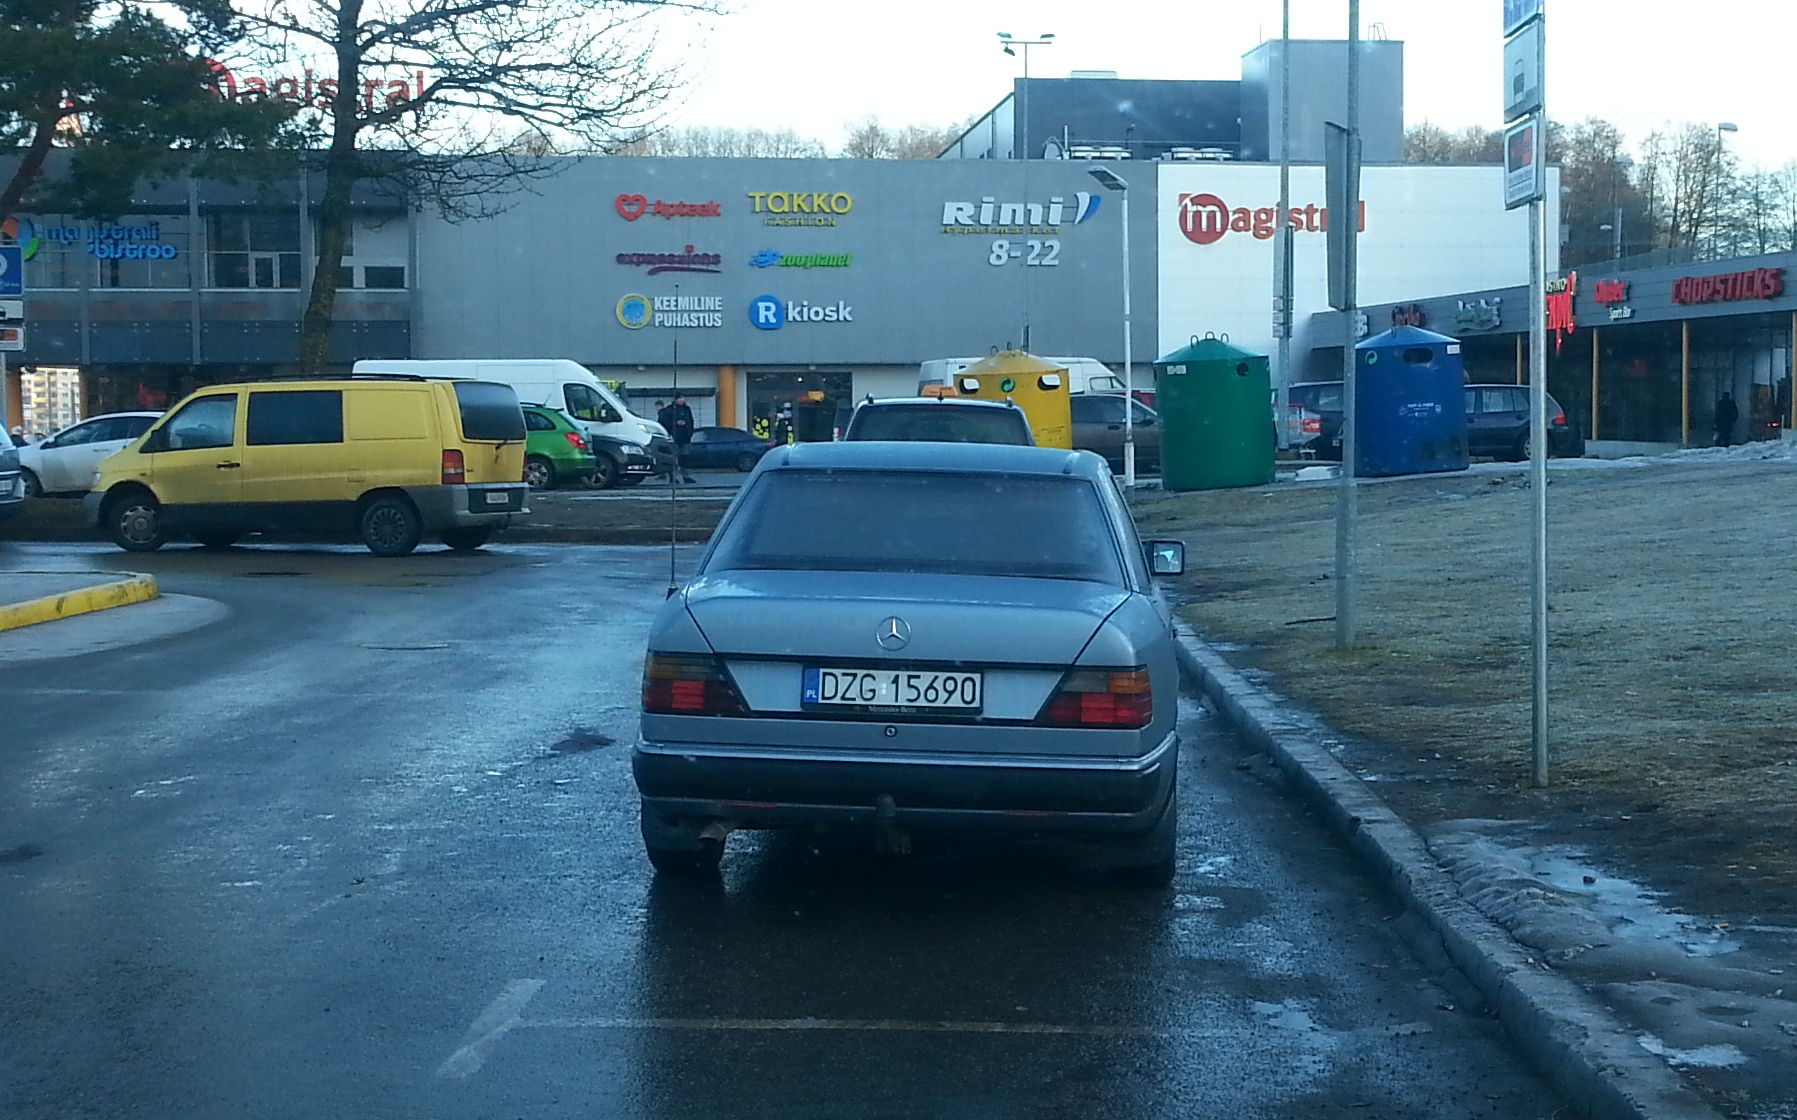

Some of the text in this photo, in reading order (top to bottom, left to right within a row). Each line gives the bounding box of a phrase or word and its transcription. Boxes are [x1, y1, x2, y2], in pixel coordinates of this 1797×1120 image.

[205, 58, 424, 110] agisral
[653, 200, 721, 219] Apteek
[942, 197, 1063, 225] Rimi
[1179, 194, 1365, 244] magstl
[764, 217, 836, 226] FASHION
[941, 226, 1060, 236] Hypermaket
[1672, 268, 1784, 303] CHOPSTICKS
[654, 297, 722, 310] KEEMILINE
[757, 300, 853, 323] R kiosk
[655, 313, 722, 327] PUHASTUS
[806, 672, 977, 705] PL DZG 15690
